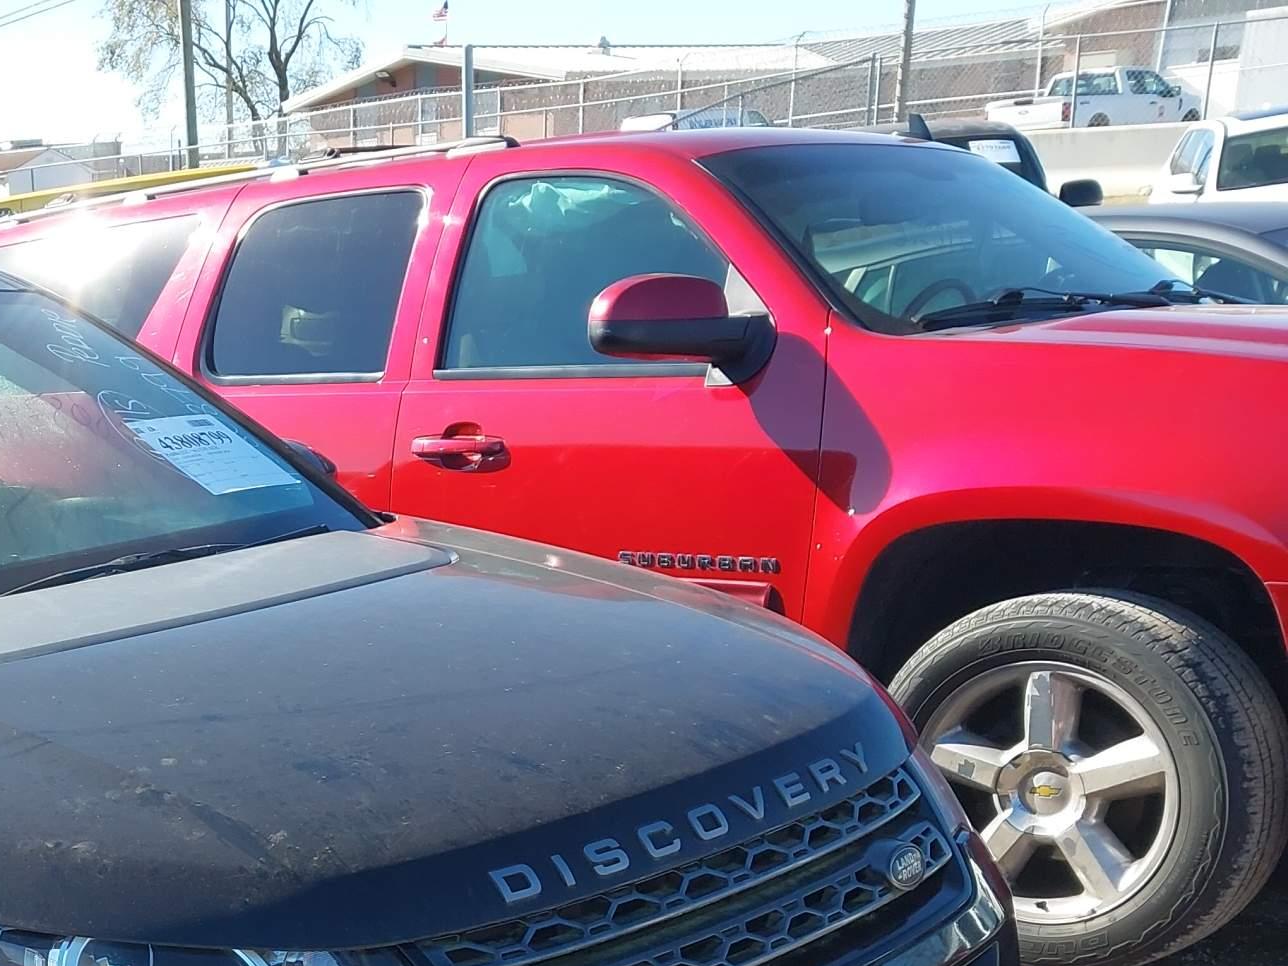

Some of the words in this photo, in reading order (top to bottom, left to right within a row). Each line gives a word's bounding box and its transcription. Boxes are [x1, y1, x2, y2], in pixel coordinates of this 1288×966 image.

[158, 429, 233, 451] 43808799
[617, 550, 781, 575] SUBURBAN
[488, 741, 869, 905] DISCOVERY
